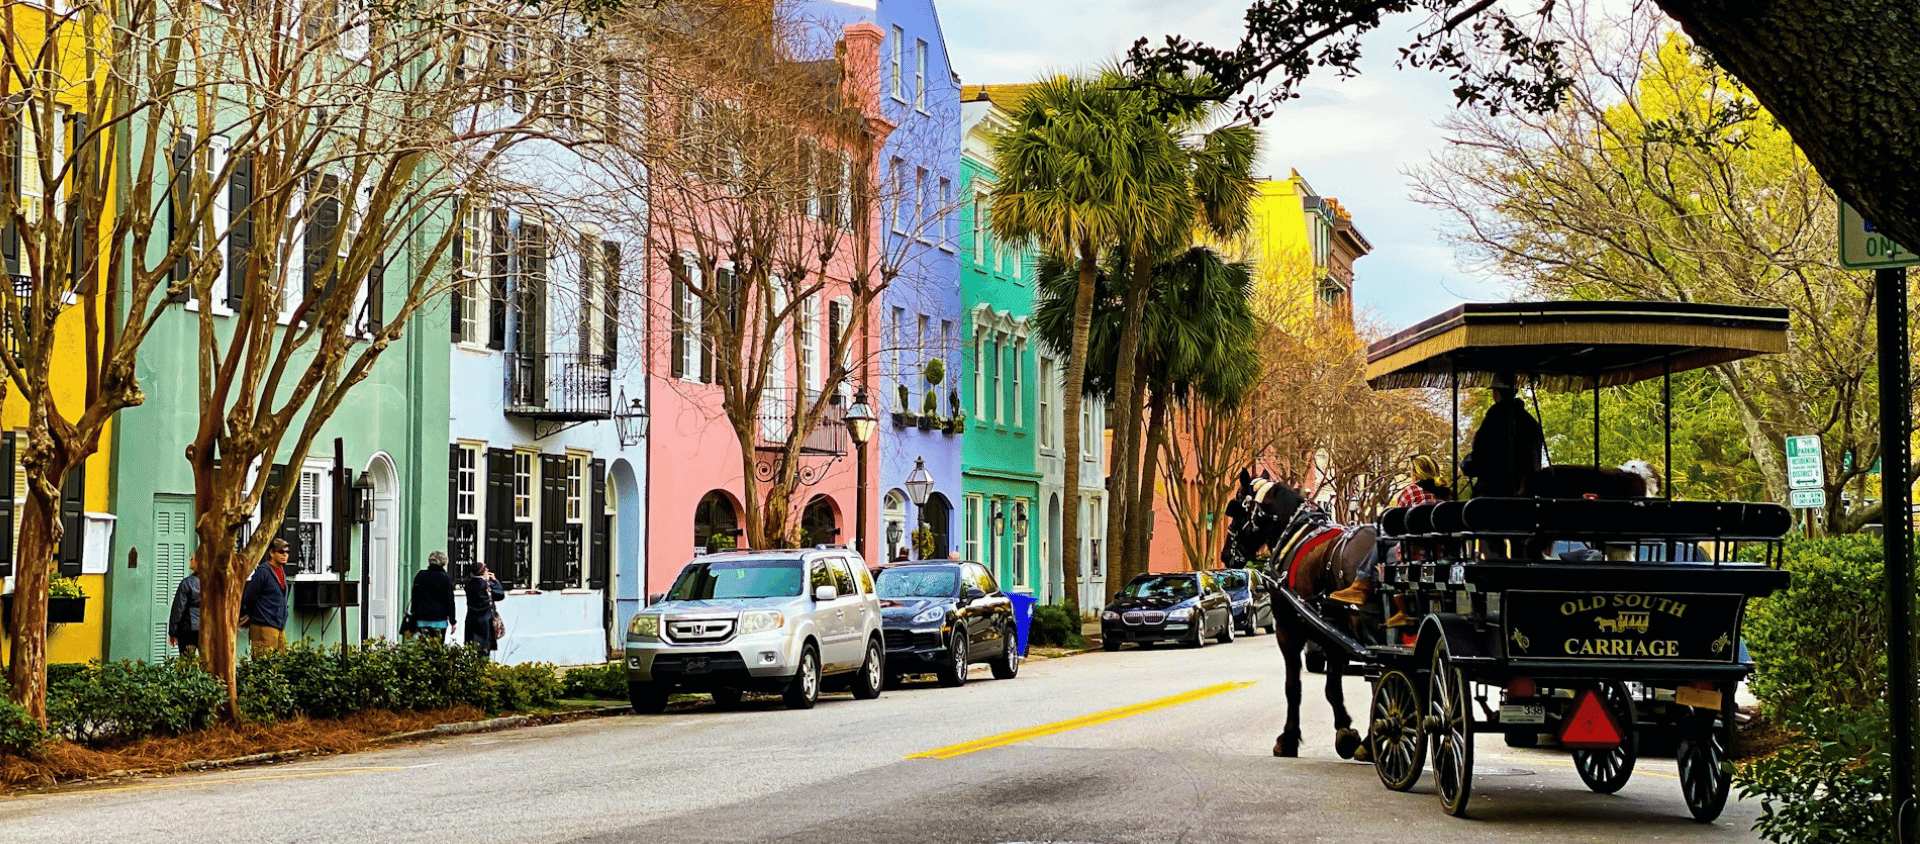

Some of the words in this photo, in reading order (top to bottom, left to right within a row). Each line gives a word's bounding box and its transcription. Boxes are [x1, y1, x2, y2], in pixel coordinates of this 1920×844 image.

[1866, 236, 1903, 257] ONL
[1792, 457, 1817, 465] RESIDENTIAL
[1560, 595, 1607, 616] OLD
[1612, 593, 1688, 618] SOUTH
[1563, 638, 1680, 657] CARRIAGE
[1524, 705, 1543, 715] 338
